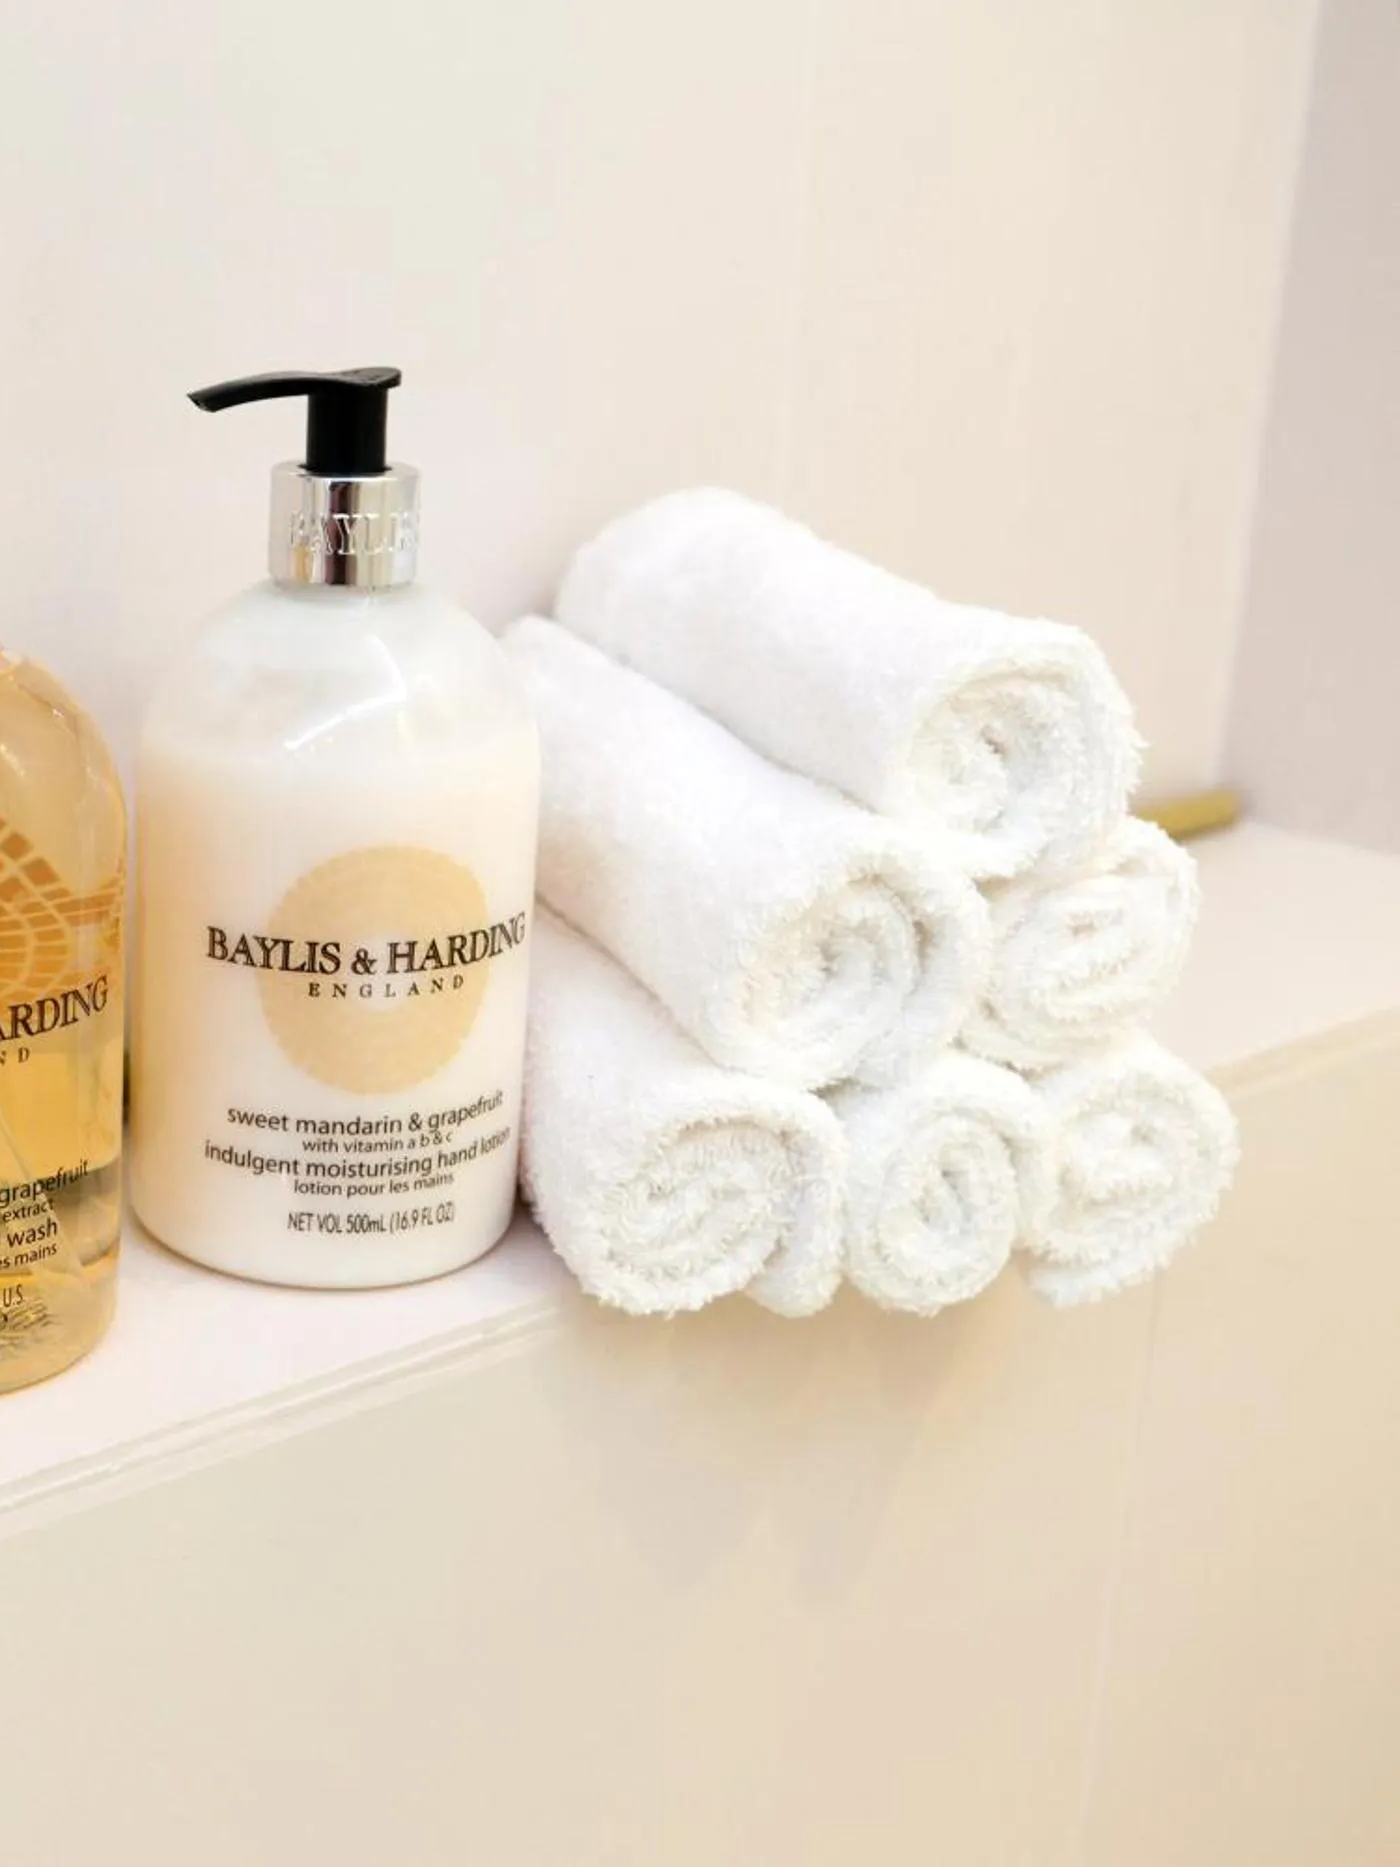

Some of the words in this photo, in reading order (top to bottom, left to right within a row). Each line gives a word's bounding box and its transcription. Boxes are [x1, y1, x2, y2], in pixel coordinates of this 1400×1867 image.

[207, 925, 342, 975] BAYLIS
[351, 948, 378, 976] &
[387, 911, 526, 975] HARDING
[307, 974, 465, 999] ENGLAND
[227, 1107, 290, 1133] sweet
[296, 1114, 402, 1136] mandarin
[408, 1111, 423, 1132] &
[428, 1089, 504, 1134] grapefruit
[302, 1137, 339, 1154] with
[342, 1136, 404, 1154] vitamin
[407, 1138, 416, 1150] a
[420, 1133, 430, 1148] b
[432, 1131, 443, 1146] &
[445, 1130, 453, 1143] c
[205, 1139, 300, 1176] indulgent
[306, 1156, 433, 1178] moisturising
[438, 1141, 479, 1168] hand
[294, 1179, 343, 1197] lotion
[347, 1183, 385, 1199] pour
[389, 1179, 410, 1193] les
[414, 1172, 455, 1191] mains
[2, 1198, 55, 1224] extract
[287, 1212, 313, 1232] NET
[317, 1212, 342, 1234] VOL
[346, 1212, 386, 1235] 500mL
[6, 1217, 58, 1249] wash
[14, 1242, 58, 1267] mains
